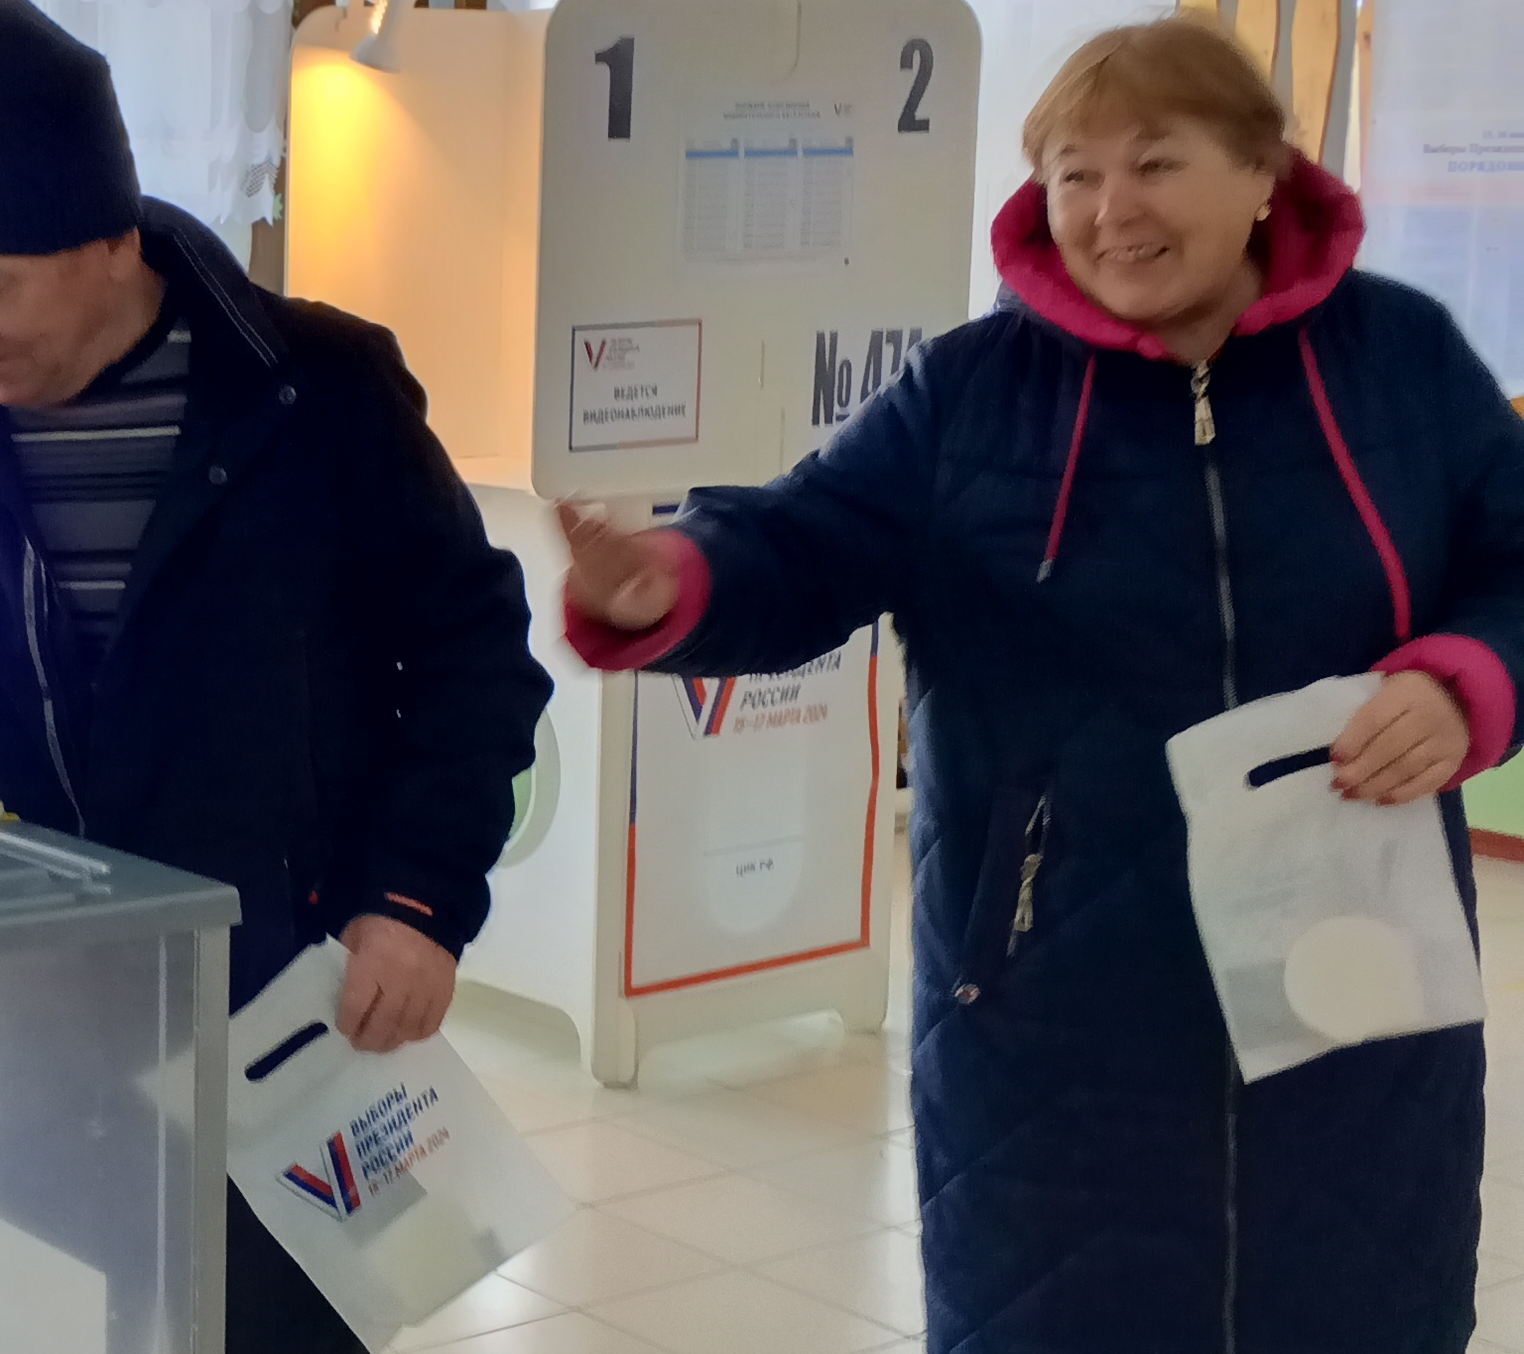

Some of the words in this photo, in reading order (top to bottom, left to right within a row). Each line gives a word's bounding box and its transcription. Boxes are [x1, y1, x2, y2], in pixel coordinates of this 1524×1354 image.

[594, 36, 636, 141] 1
[898, 38, 935, 134] 2
[811, 330, 852, 425] №
[860, 327, 922, 404] 47
[739, 682, 801, 712] РОССИИ
[350, 1081, 408, 1137] ВЫБОРЫ
[356, 1085, 439, 1160] ПРЕЗИДЕНТА
[360, 1127, 414, 1181] РОССИИ
